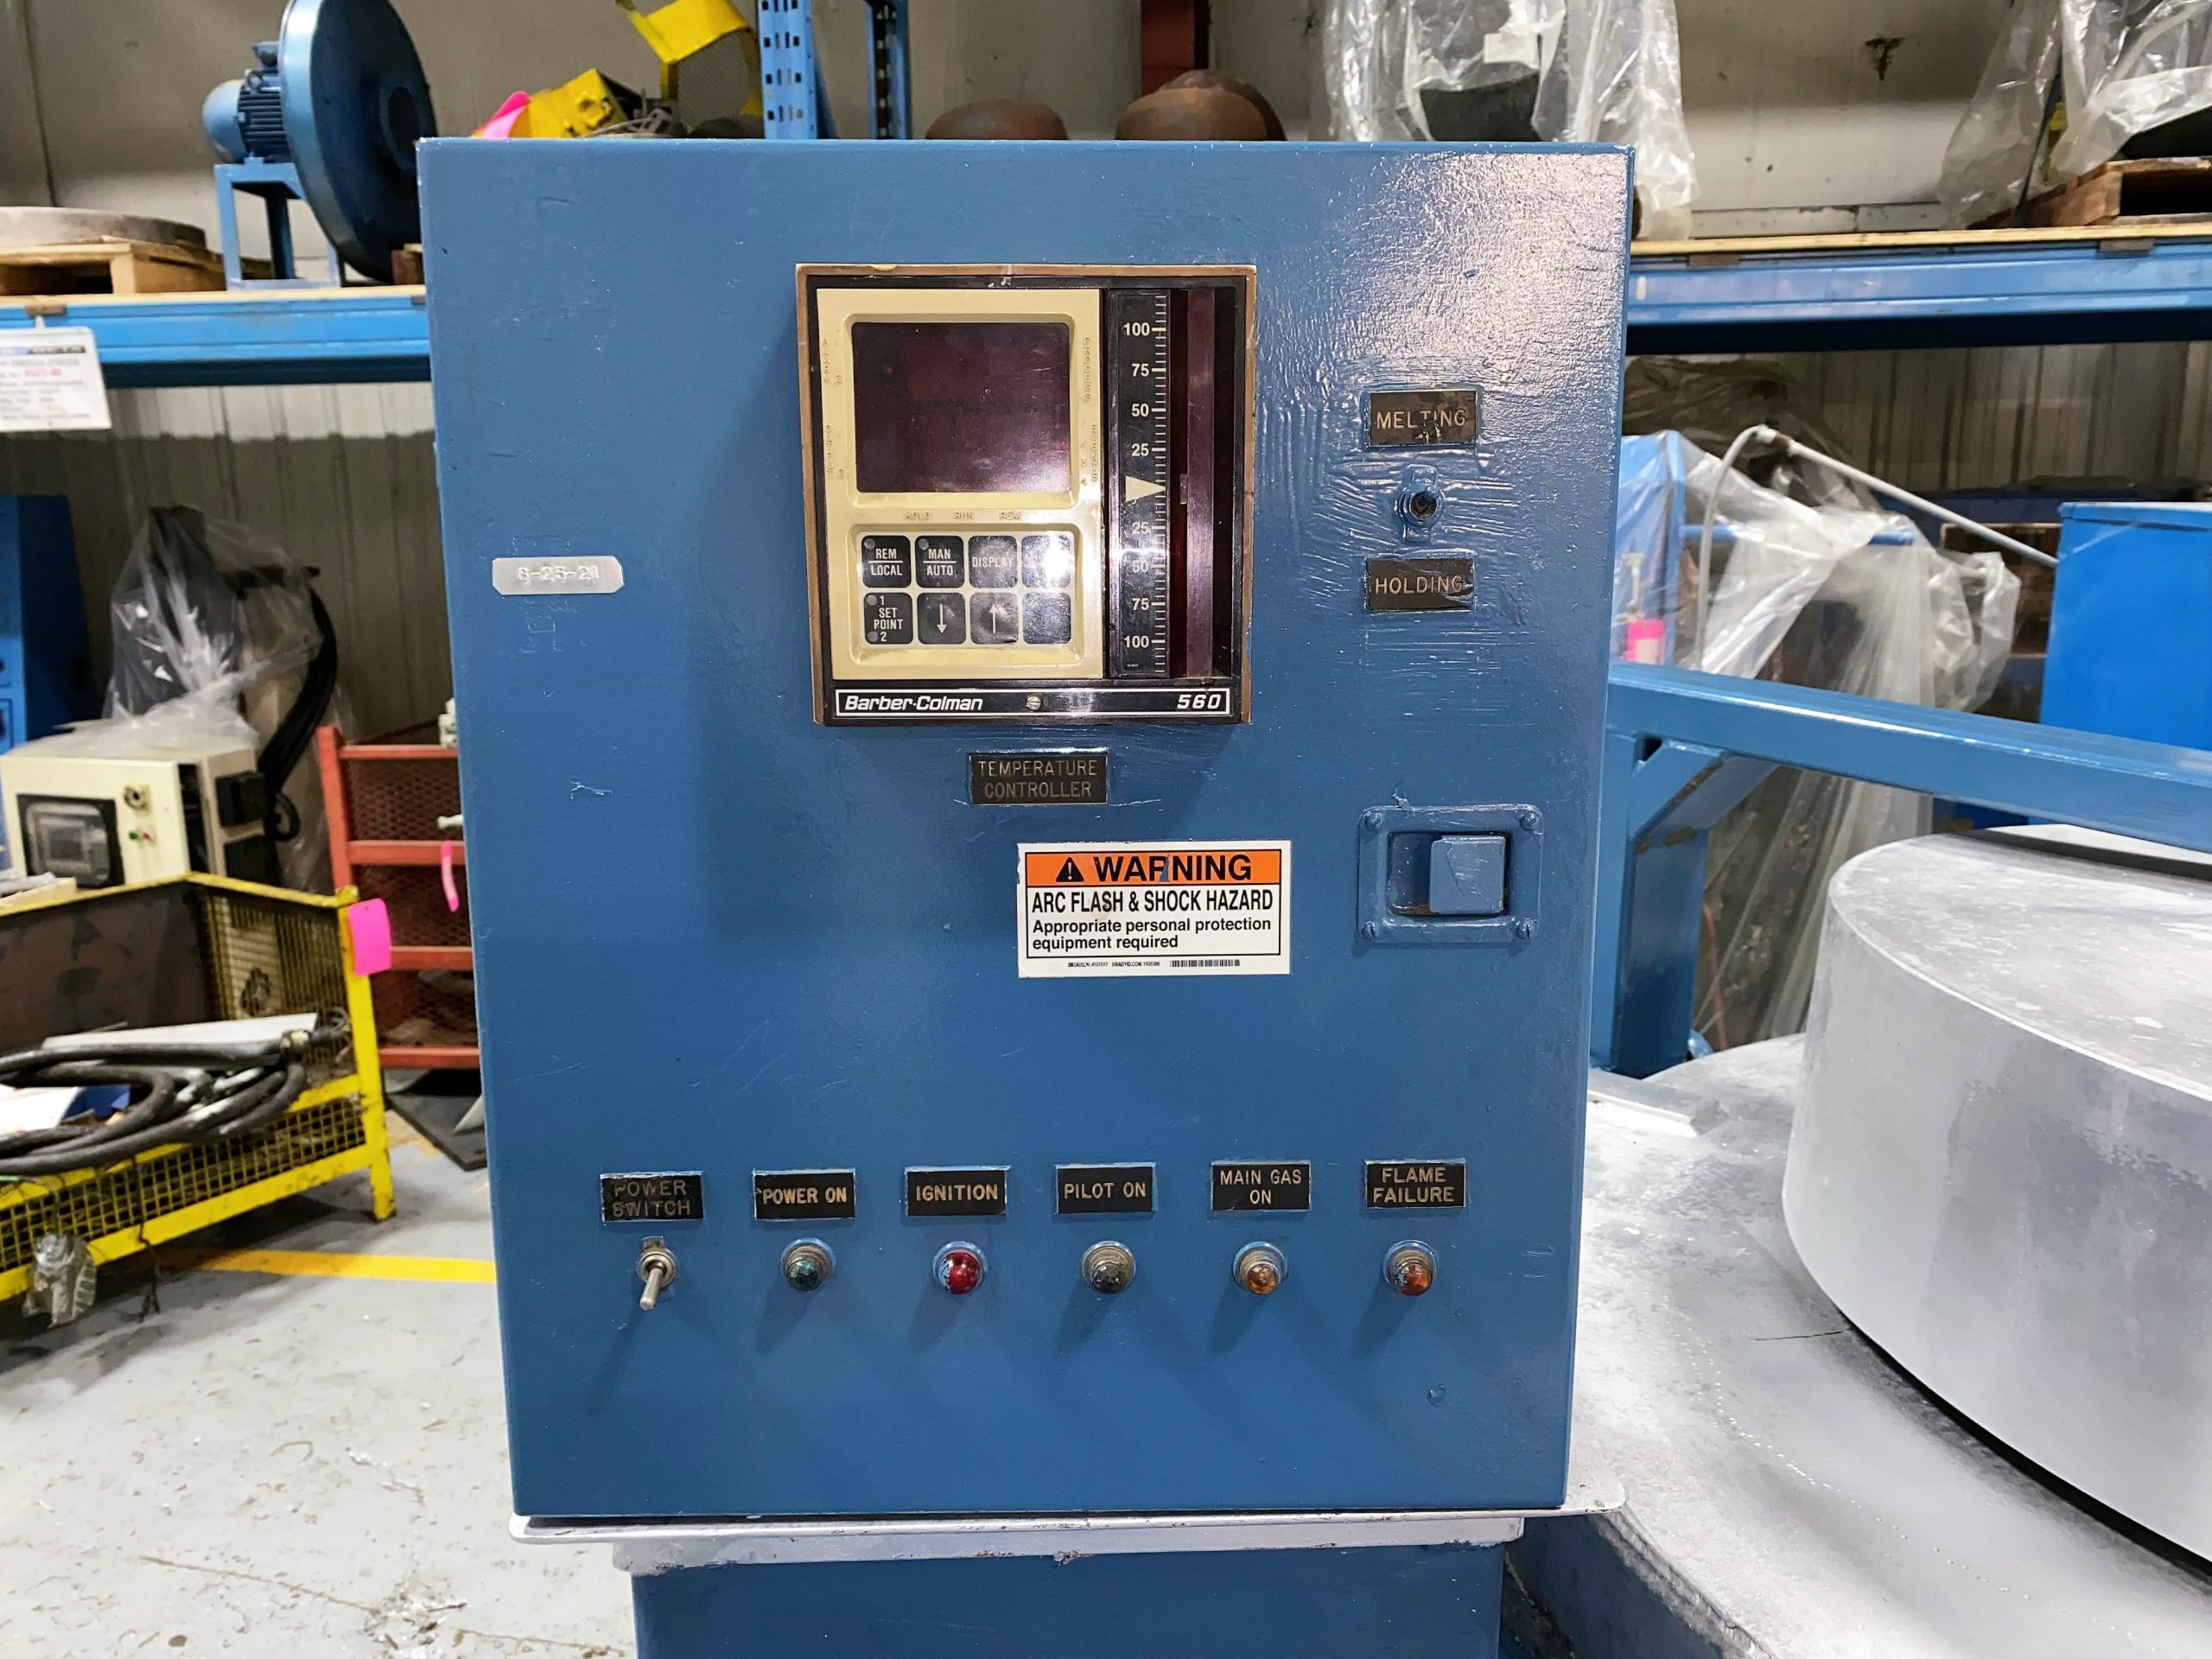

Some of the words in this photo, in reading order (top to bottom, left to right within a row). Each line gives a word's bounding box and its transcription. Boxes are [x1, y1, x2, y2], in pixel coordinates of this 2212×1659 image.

[1123, 322, 1150, 336] 100
[1131, 363, 1150, 378] 75
[1131, 403, 1150, 417] 50
[1376, 409, 1467, 429] MELTING
[1131, 442, 1150, 457] 25
[906, 511, 932, 520] HOLD
[954, 511, 975, 520] RUN
[999, 511, 1021, 520] REM
[1131, 521, 1150, 535] 25
[875, 548, 897, 560] REM
[928, 548, 951, 560] MAN
[971, 556, 1014, 568] DISPLAY
[1131, 561, 1149, 574] 50
[871, 564, 903, 576] LOCAL
[926, 564, 953, 576] AUTO
[1374, 575, 1464, 595] HOLDING
[880, 596, 886, 606] 1
[1131, 597, 1150, 611] 75
[878, 607, 898, 619] SET
[874, 619, 904, 631] POINT
[880, 632, 887, 642] 2
[1123, 636, 1150, 649] 100
[1177, 694, 1222, 709] 560
[978, 760, 1098, 778] TEMPERATURE
[983, 781, 1092, 798] CONTROLLER
[1032, 891, 1066, 913] ARC
[1071, 891, 1123, 912] FLASH
[1128, 891, 1140, 912] &
[1143, 890, 1202, 912] SHOCK
[1206, 889, 1273, 911] HAZARD
[1033, 918, 1122, 936] Appropriate
[1125, 918, 1191, 935] personal
[1195, 918, 1271, 934] protection
[1033, 937, 1112, 953] equipment
[1116, 935, 1179, 951] required
[1219, 1169, 1262, 1185] MAIN
[1270, 1168, 1302, 1185] GAS
[1382, 1166, 1446, 1184] FLAME
[613, 1179, 687, 1198] POWER
[762, 1187, 819, 1205] POWER
[824, 1186, 848, 1203] ON
[915, 1183, 999, 1202] IGNITION
[1064, 1182, 1115, 1199] PILOT
[1123, 1181, 1147, 1198] ON
[1373, 1186, 1455, 1204] FAILURE
[1249, 1189, 1272, 1205] ON
[613, 1198, 691, 1217] SWITCH
